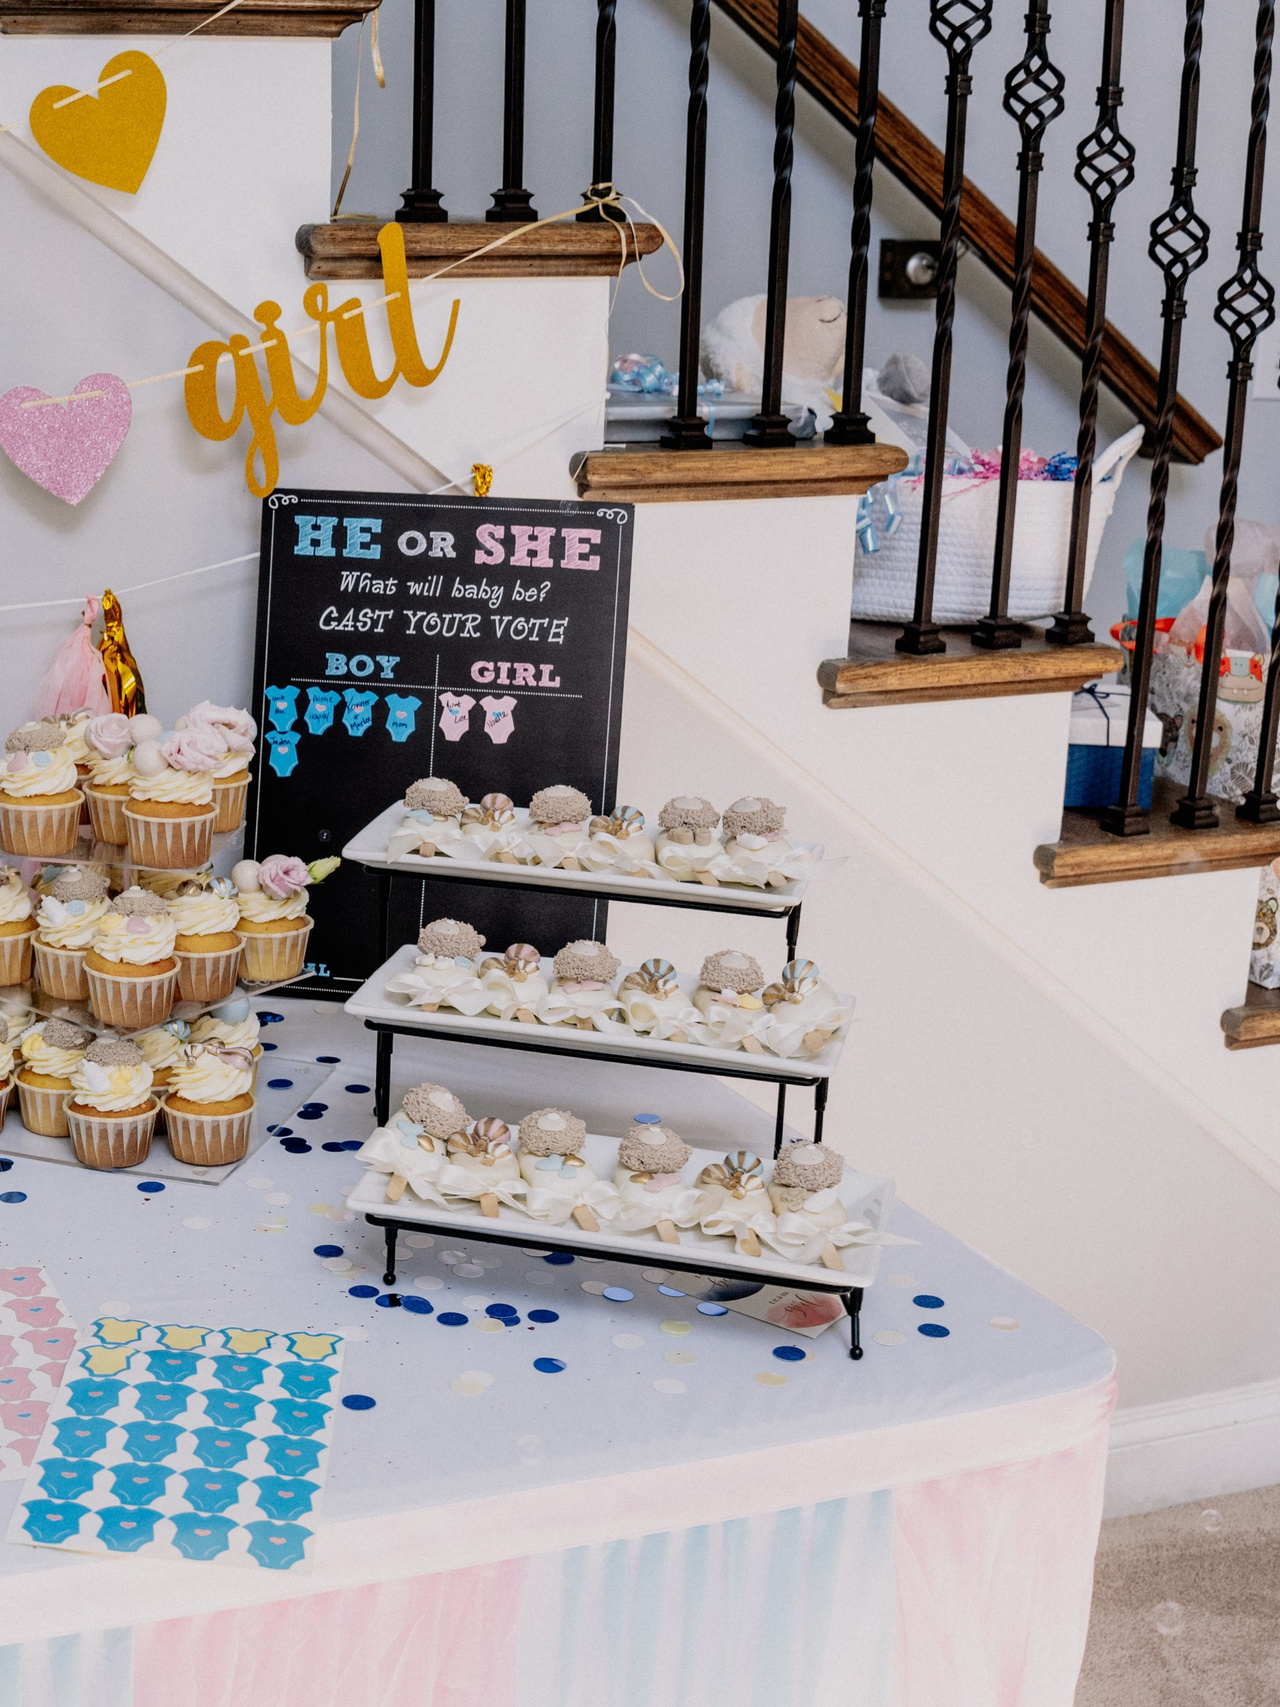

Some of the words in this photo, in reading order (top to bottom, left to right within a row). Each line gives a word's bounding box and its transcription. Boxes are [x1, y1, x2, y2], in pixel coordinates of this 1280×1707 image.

[184, 222, 459, 498] girl
[294, 515, 383, 560] HE
[397, 530, 456, 558] OR
[475, 523, 602, 571] SHE
[340, 571, 398, 595] What
[407, 575, 444, 597] will
[451, 577, 504, 608] baby
[512, 580, 551, 603] be?
[319, 606, 393, 633] CAST
[403, 610, 481, 638] YOUR
[491, 615, 568, 645] VOTE
[325, 652, 400, 679] BOY
[471, 661, 560, 688] GIRL
[768, 1291, 789, 1305] team
